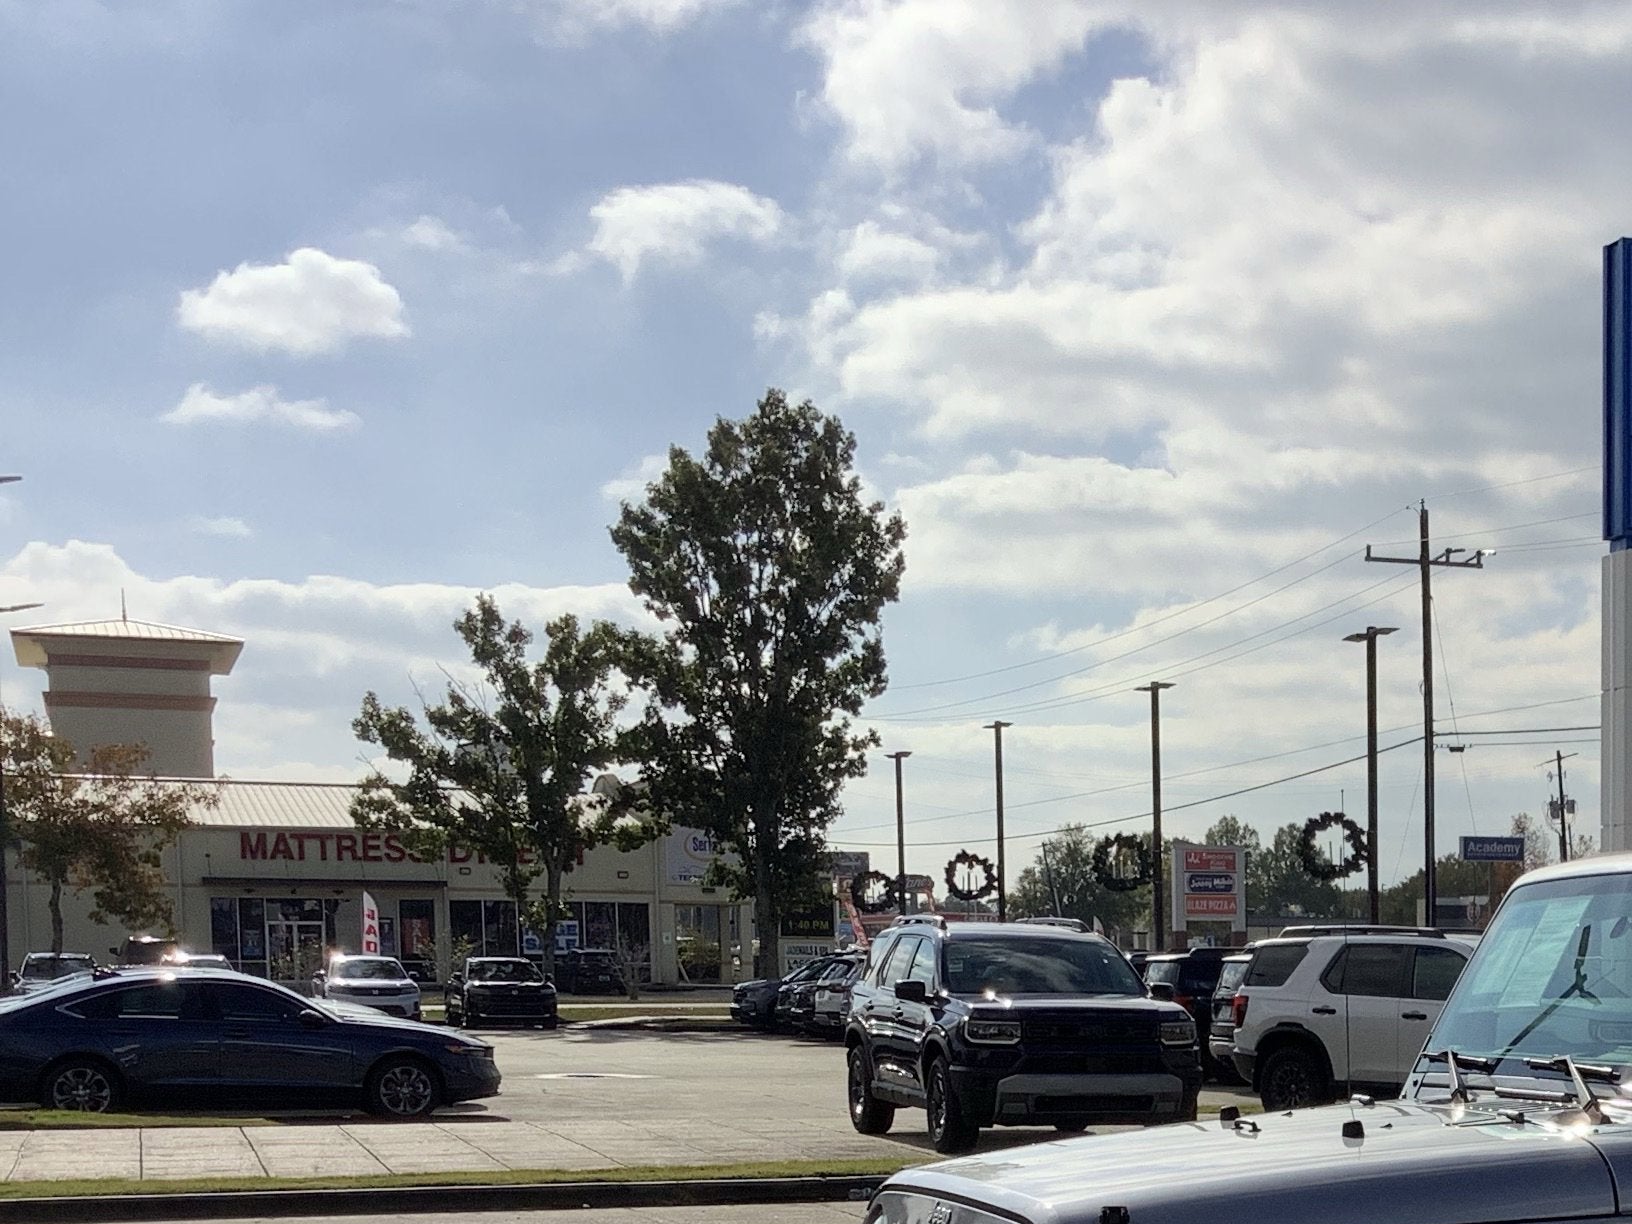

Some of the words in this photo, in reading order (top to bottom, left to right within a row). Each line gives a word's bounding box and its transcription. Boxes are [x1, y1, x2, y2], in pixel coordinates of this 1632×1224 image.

[1467, 842, 1521, 855] Academy
[1187, 899, 1208, 910] BLAZE
[1209, 899, 1229, 910] PIZZA
[812, 920, 829, 929] PM
